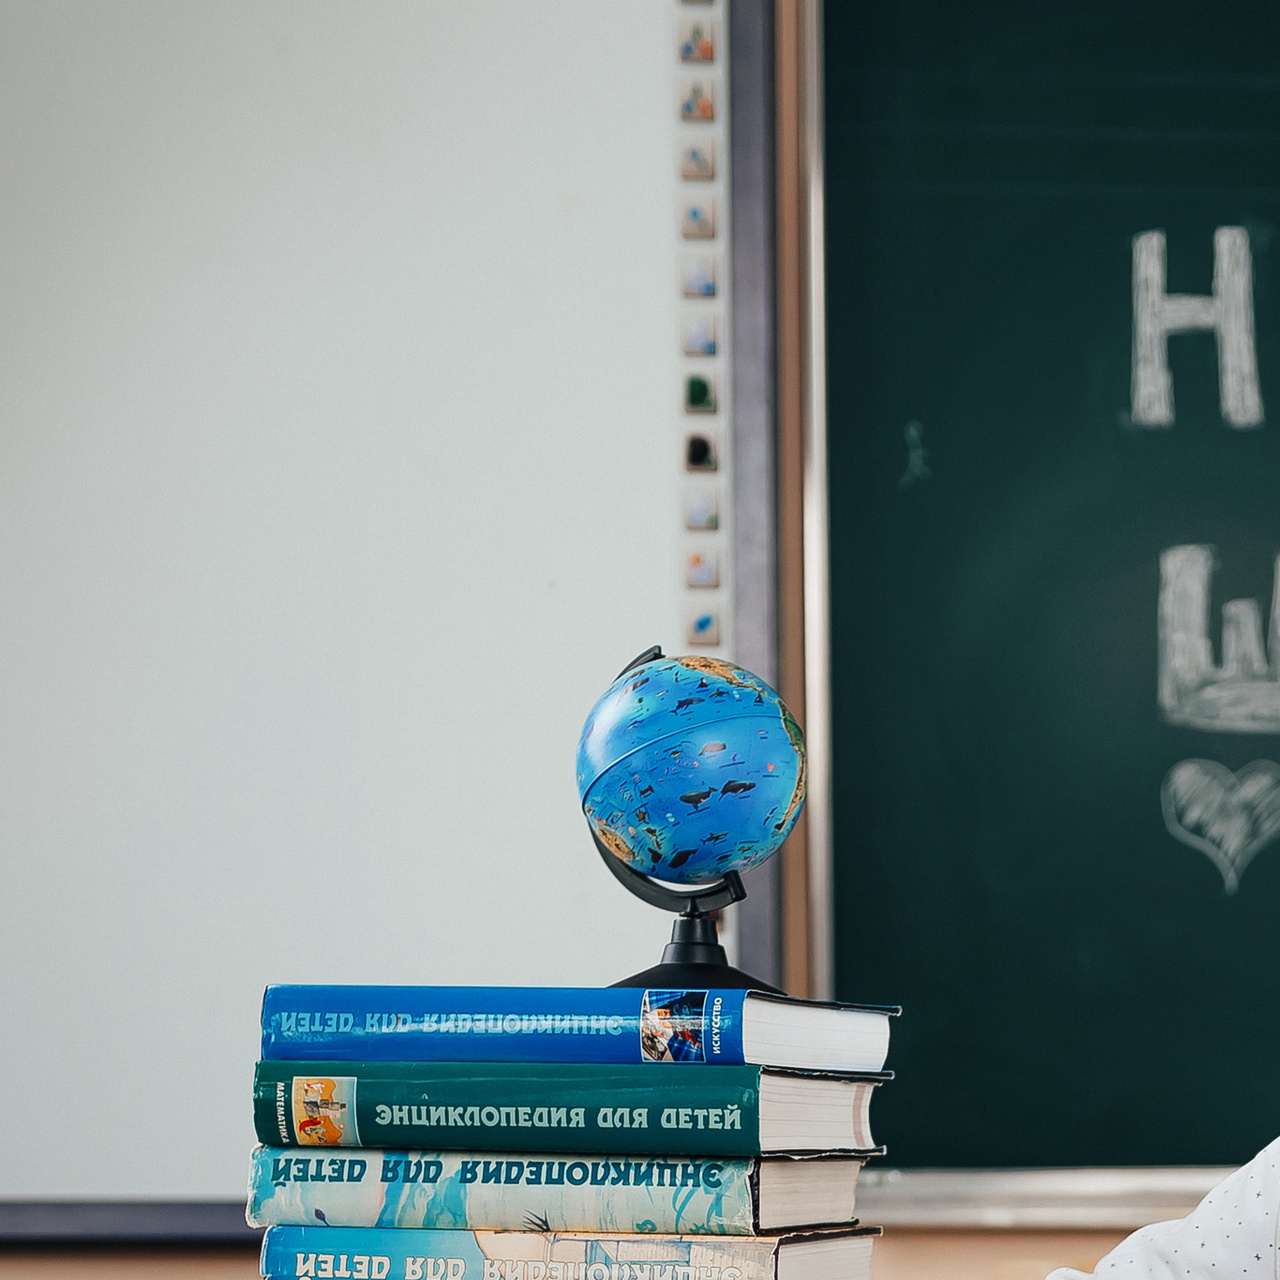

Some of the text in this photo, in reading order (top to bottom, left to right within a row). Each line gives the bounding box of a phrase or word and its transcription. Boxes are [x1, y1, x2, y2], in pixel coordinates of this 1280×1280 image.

[280, 1011, 624, 1036] ЭНЦИКЛОПЕДИЯ ДЛЯ ДЕТЕЙ
[712, 996, 723, 1055] ИСКУССТВО
[275, 1081, 290, 1144] МАТЕМАТИКА
[375, 1104, 742, 1130] ЭНЦИКЛОПЕДИЯ ДЛЯ ДЕТЕЙ
[271, 1158, 724, 1188] ЭНЦИКЛОПЕДИЯ ДЛЯ ДЕТЕЙ
